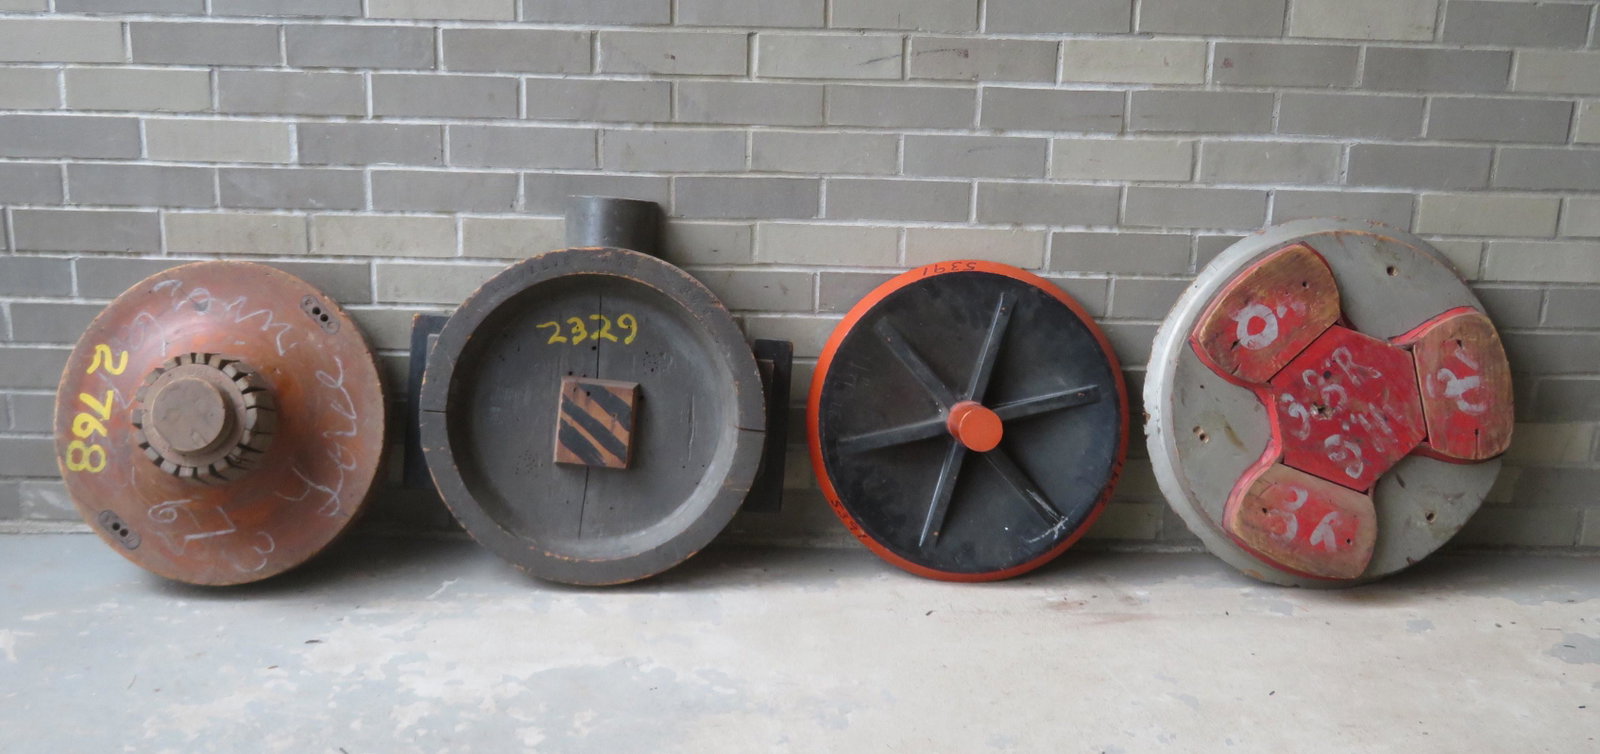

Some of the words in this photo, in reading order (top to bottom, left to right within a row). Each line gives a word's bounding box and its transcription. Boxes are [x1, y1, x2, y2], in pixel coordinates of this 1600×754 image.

[922, 261, 977, 275] 5391
[536, 313, 638, 345] 2329
[65, 344, 128, 473] 2768
